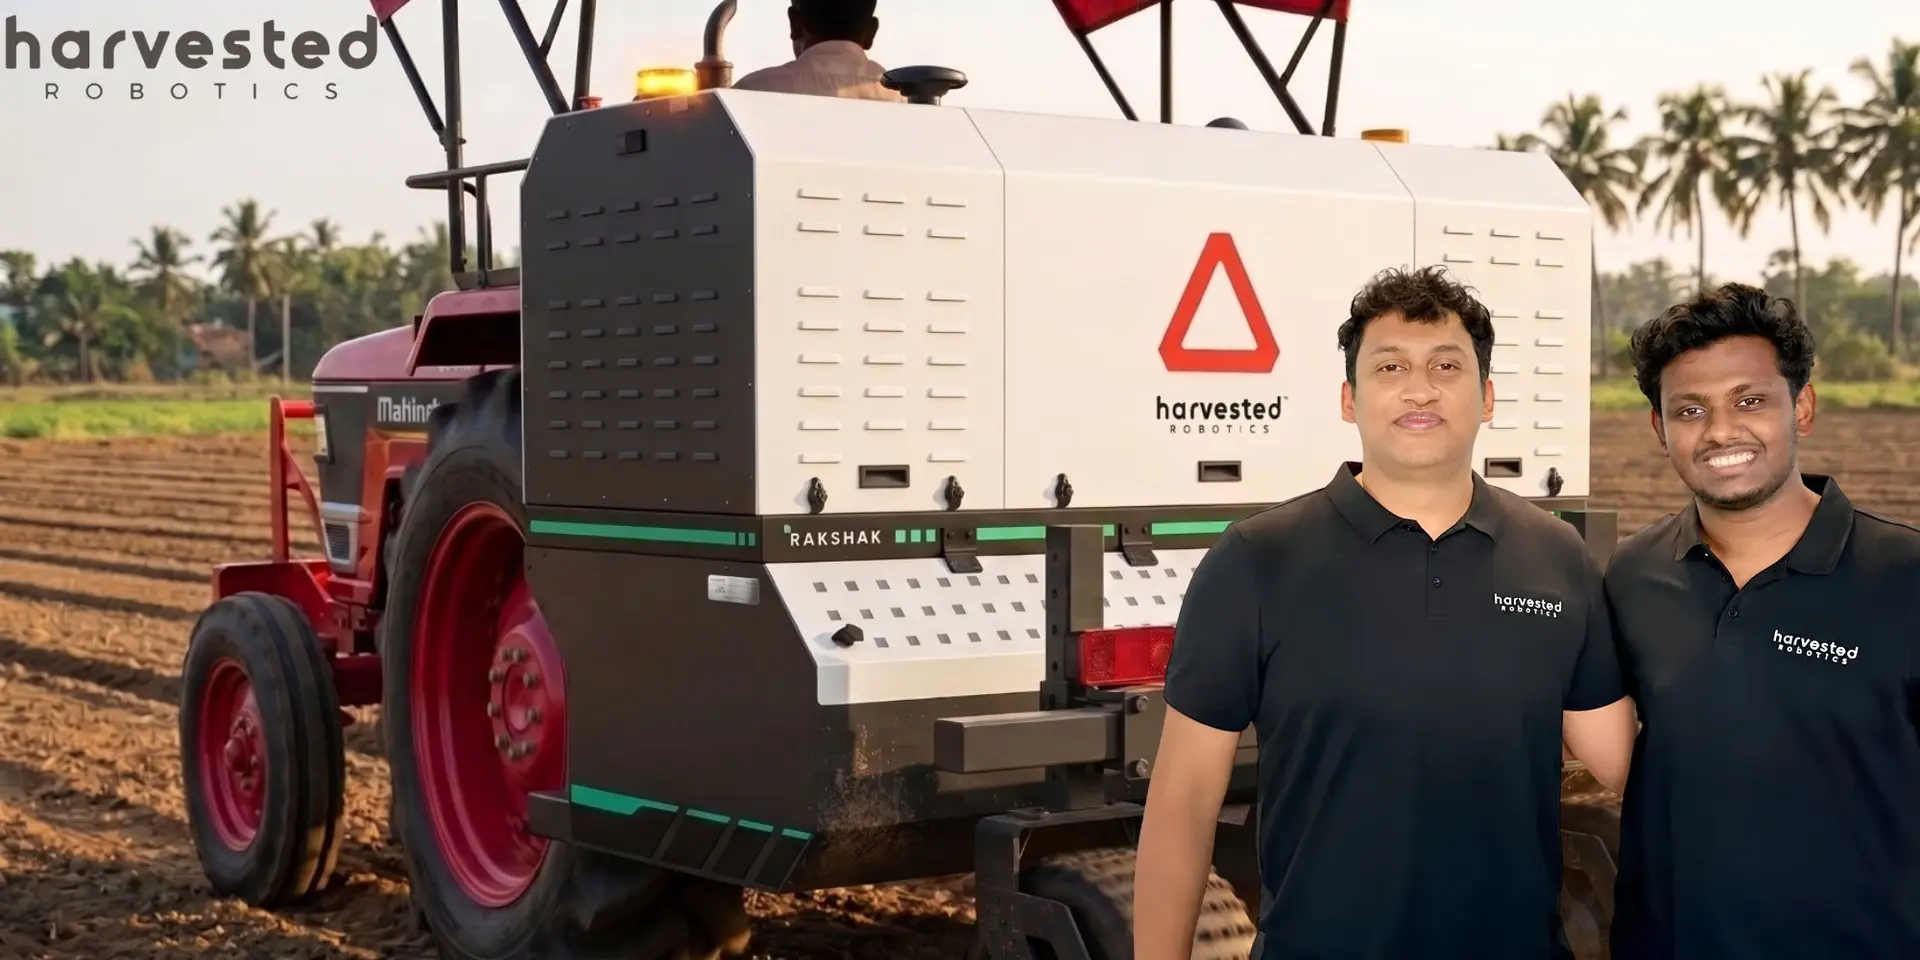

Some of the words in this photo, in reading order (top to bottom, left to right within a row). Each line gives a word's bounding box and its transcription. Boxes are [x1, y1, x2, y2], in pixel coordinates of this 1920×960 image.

[1156, 395, 1282, 420] harvested
[1169, 424, 1270, 434] ROBOTICS
[790, 530, 882, 547] RAKSHAK
[1494, 592, 1563, 613] harvested
[1773, 629, 1859, 660] harvested
